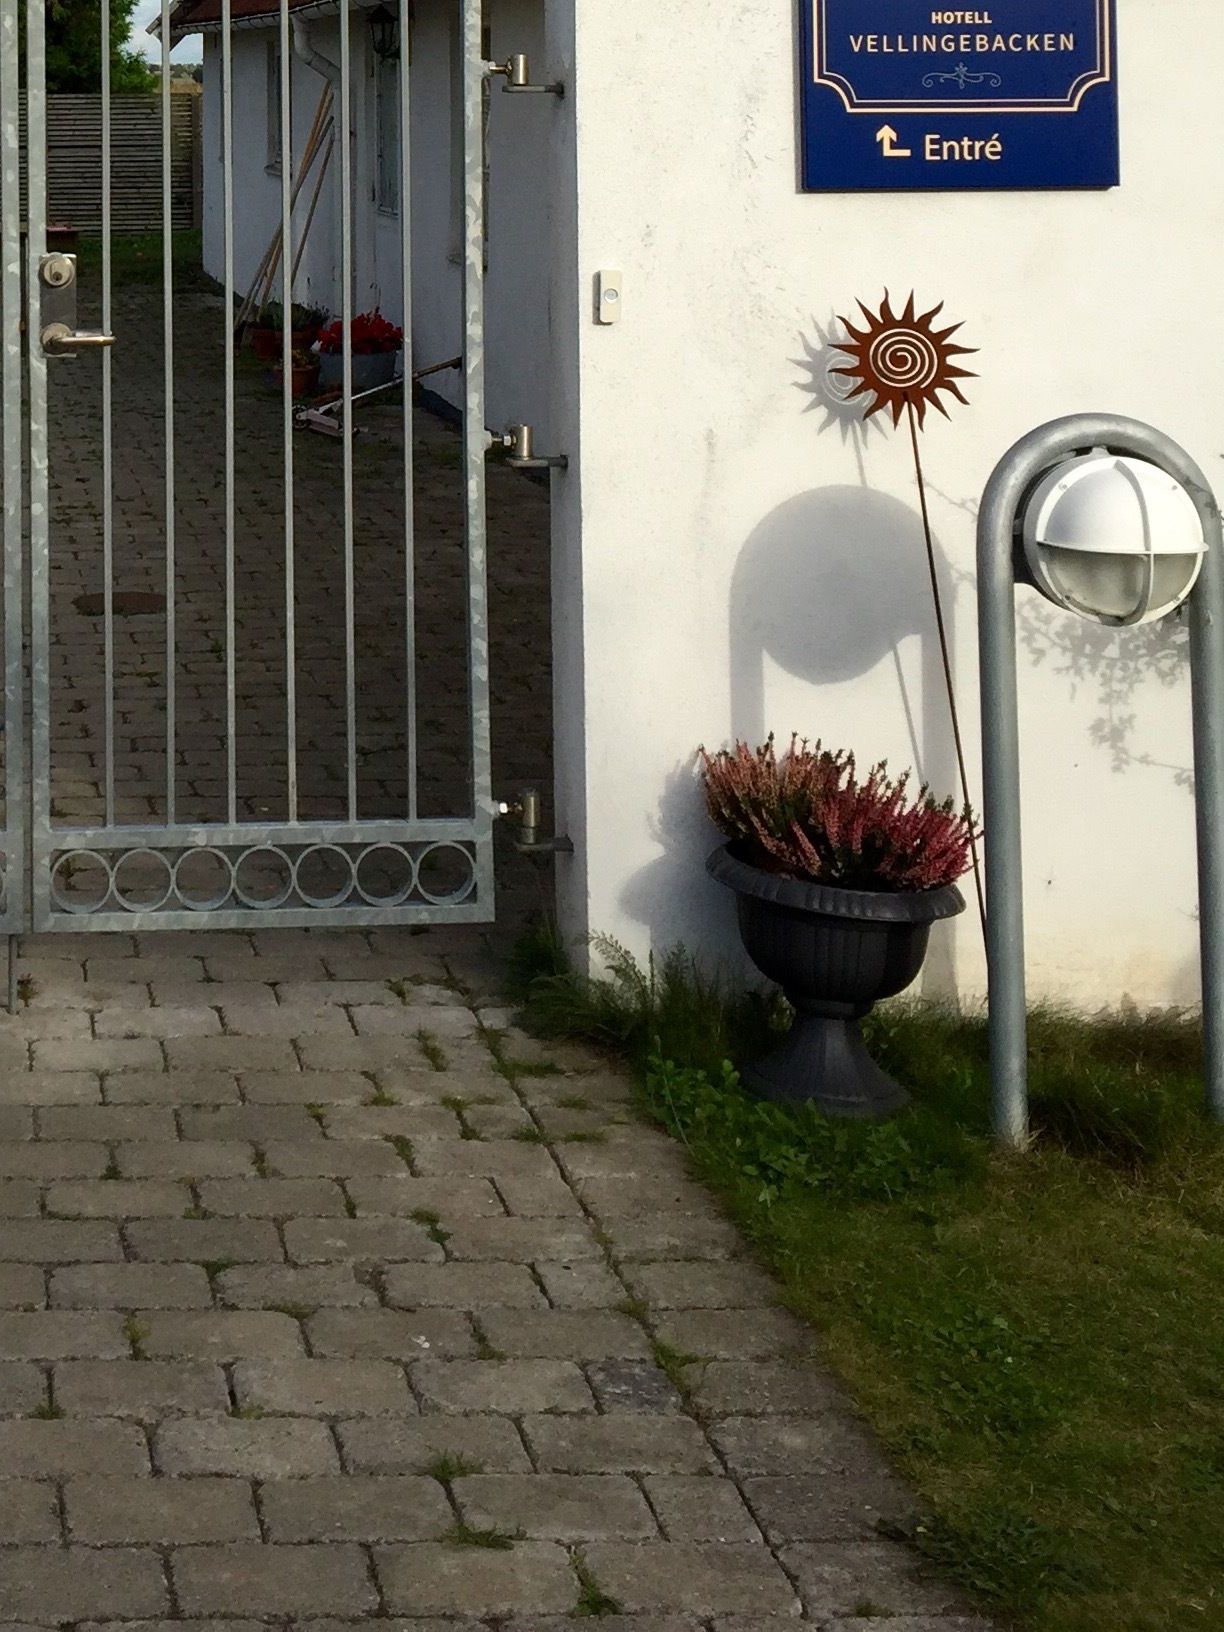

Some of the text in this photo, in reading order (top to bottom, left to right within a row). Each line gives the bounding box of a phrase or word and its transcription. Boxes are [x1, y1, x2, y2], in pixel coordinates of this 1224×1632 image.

[931, 11, 993, 25] HOTELL
[849, 33, 1074, 53] VELLINGEBACKEN
[924, 133, 1003, 161] Entré
